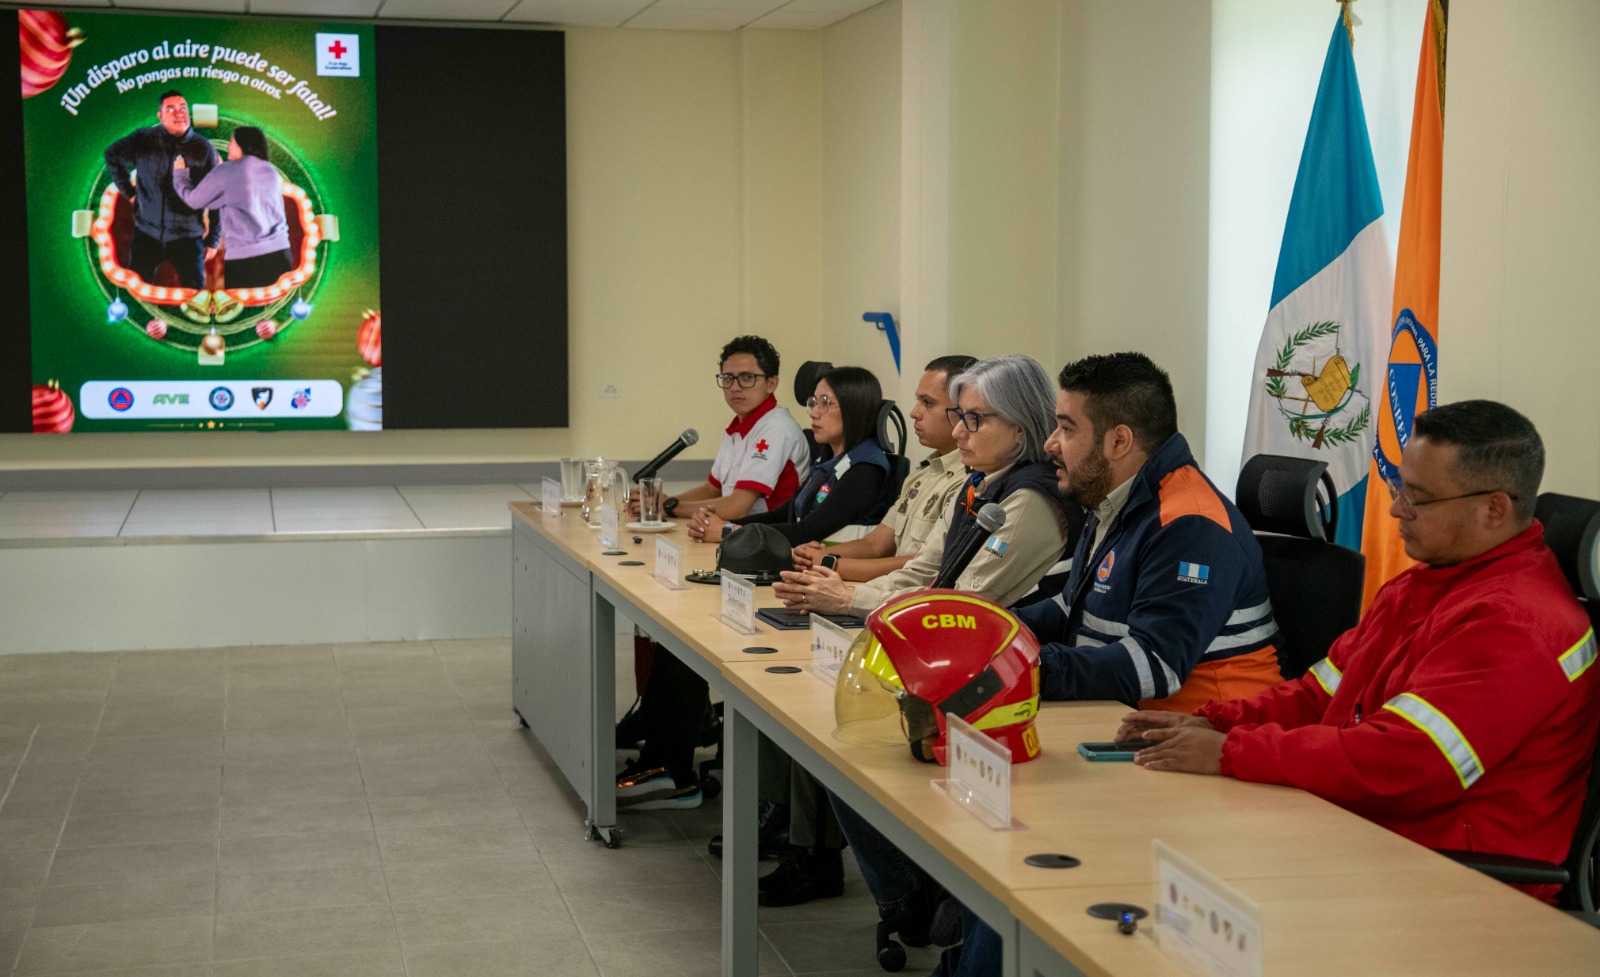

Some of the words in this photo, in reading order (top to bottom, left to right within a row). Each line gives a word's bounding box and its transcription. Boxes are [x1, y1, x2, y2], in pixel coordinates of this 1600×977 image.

[61, 83, 91, 116] ¡Un
[87, 49, 149, 88] disparo
[152, 40, 170, 60] al
[173, 39, 210, 58] aire
[211, 45, 268, 72] puede
[266, 65, 296, 85] ser
[286, 80, 337, 120] fatal!
[115, 79, 135, 94] No
[136, 67, 181, 89] pongas
[183, 66, 199, 77] en
[201, 65, 240, 83] riesgo
[240, 75, 250, 85] a
[250, 78, 282, 99] otros.
[1417, 337, 1431, 362] PARA
[1427, 362, 1435, 377] LA
[152, 393, 190, 405] AVE
[1389, 368, 1408, 447] CONRED
[921, 614, 977, 630] CBM
